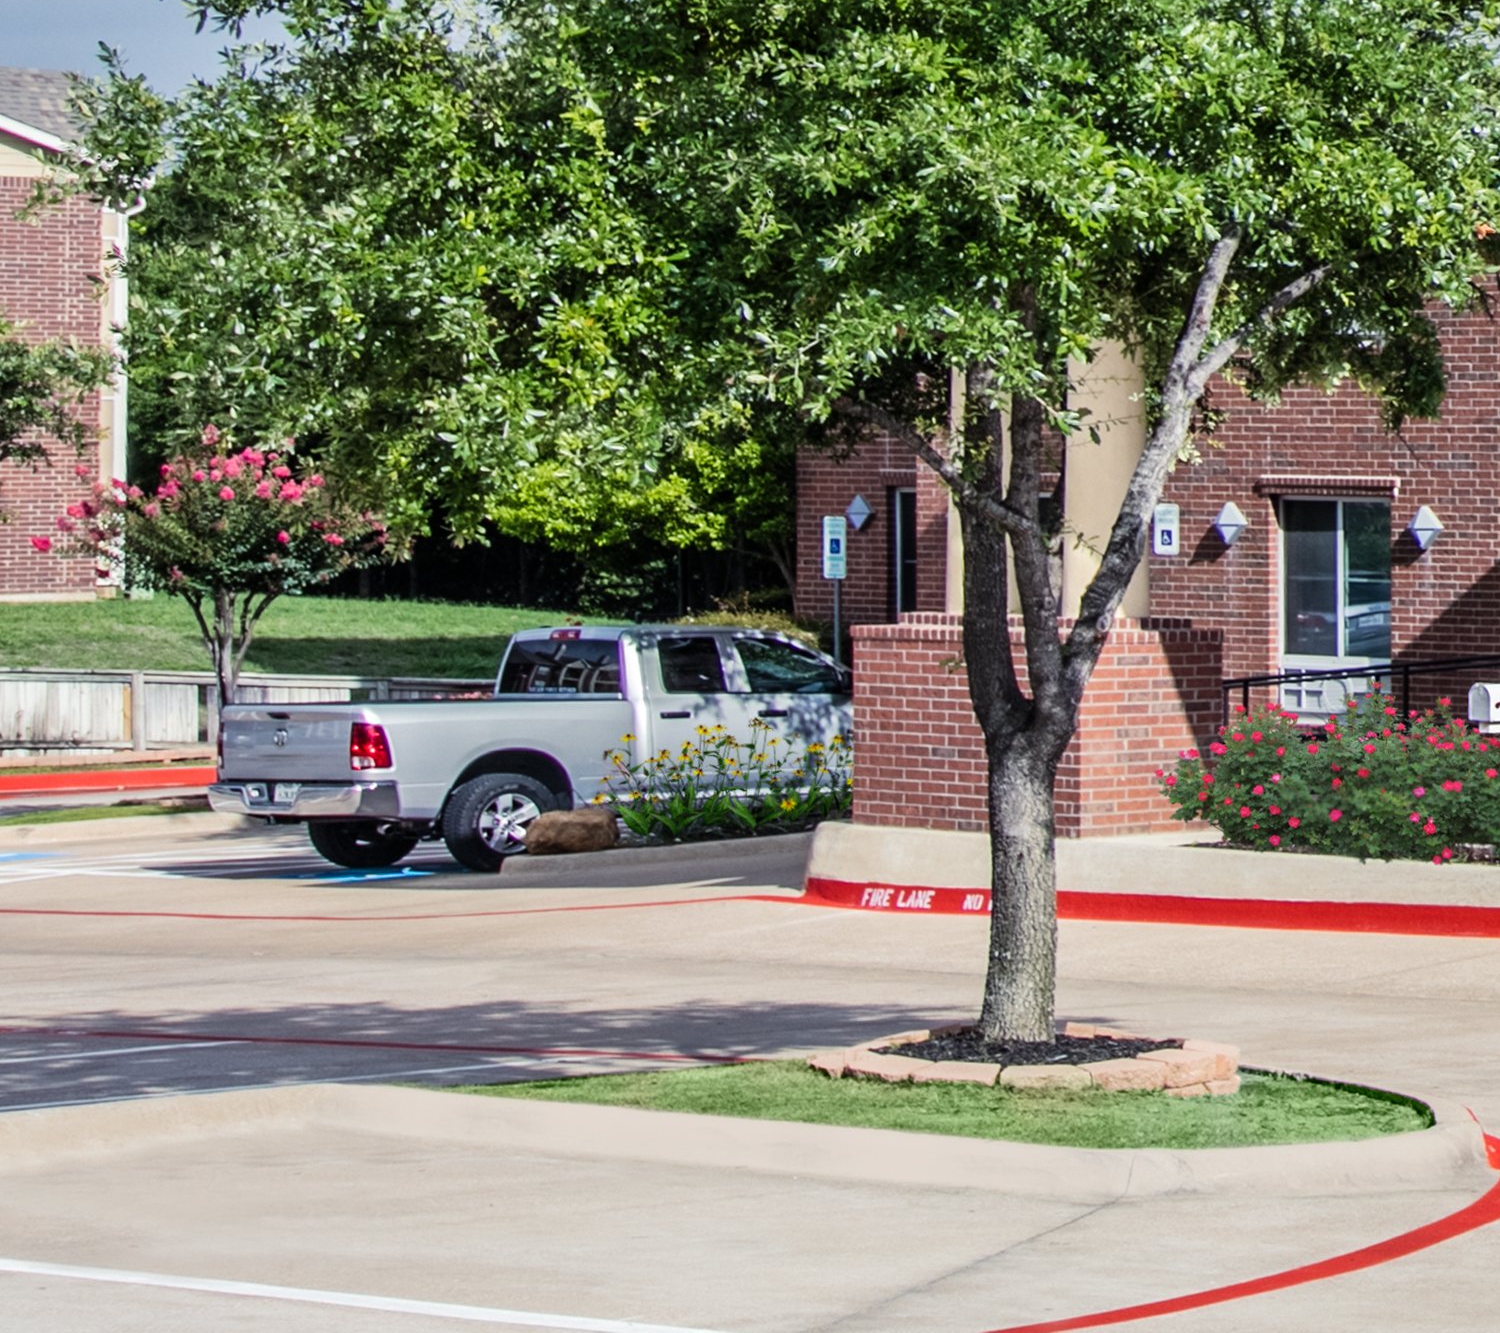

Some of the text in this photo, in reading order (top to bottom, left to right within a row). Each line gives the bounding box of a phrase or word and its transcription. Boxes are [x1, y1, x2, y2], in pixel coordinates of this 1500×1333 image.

[861, 888, 984, 911] FIRE LANE NO
